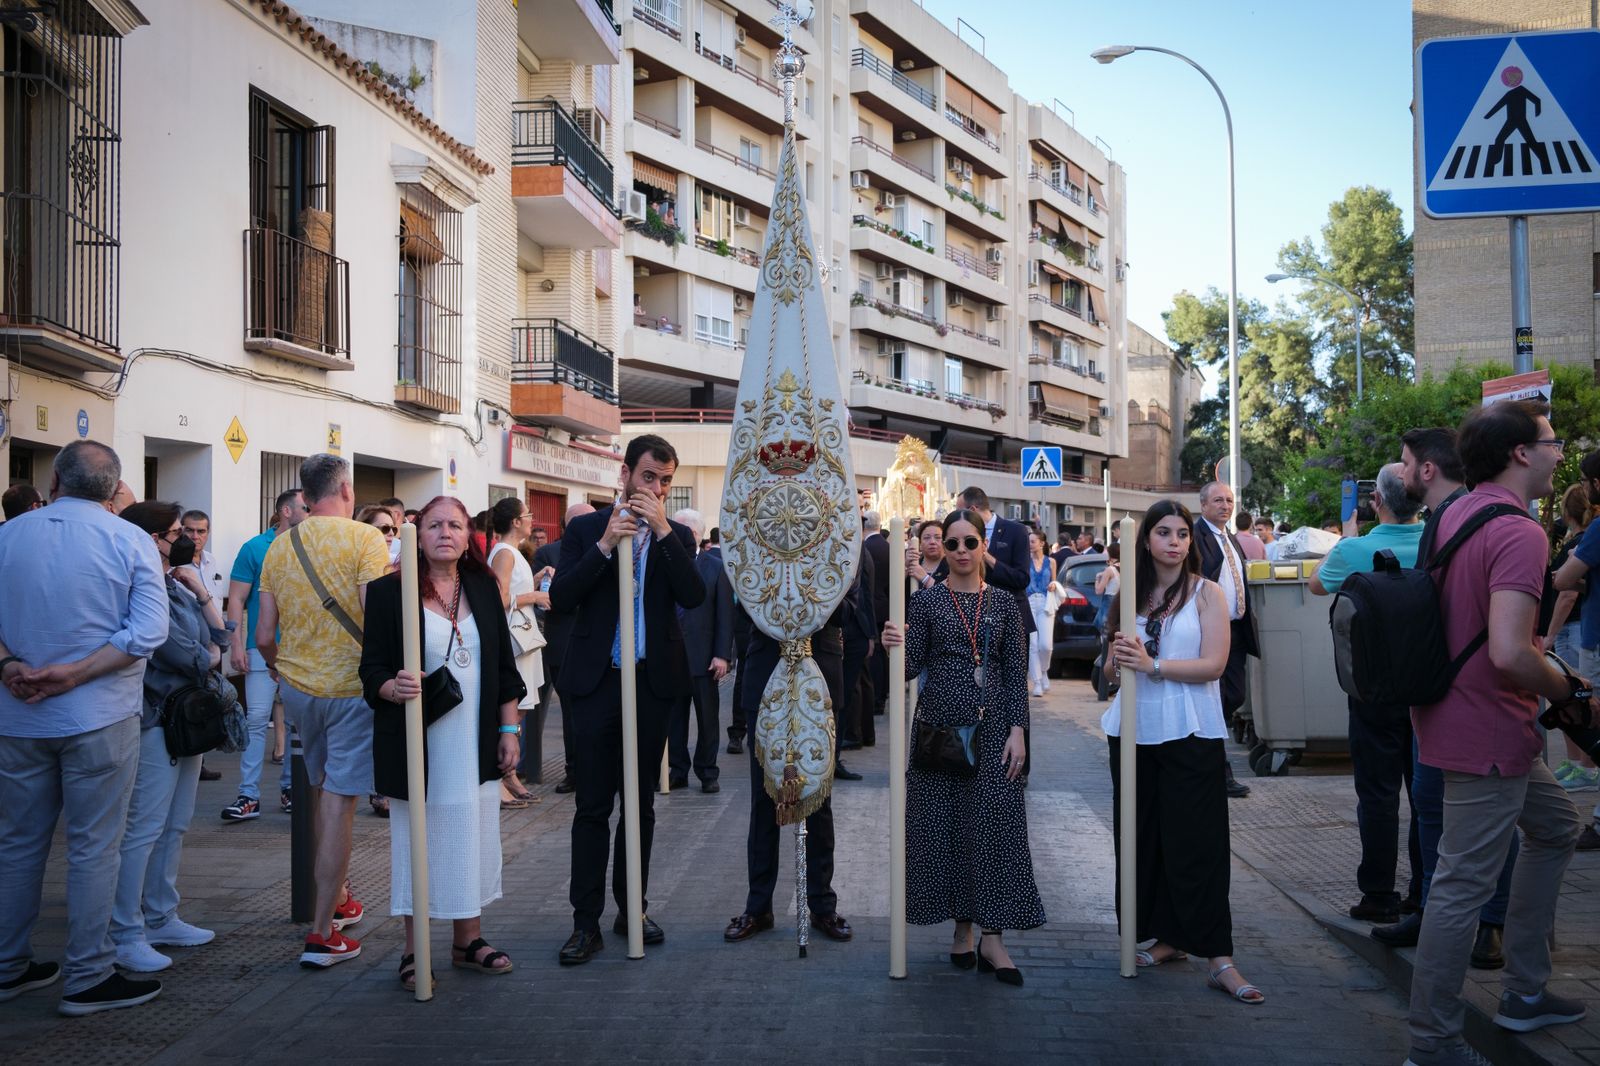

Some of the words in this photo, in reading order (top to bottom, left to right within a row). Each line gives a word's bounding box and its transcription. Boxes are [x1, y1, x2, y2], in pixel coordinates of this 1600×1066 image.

[479, 358, 489, 372] SAN
[179, 415, 188, 427] 23
[533, 458, 551, 473] VENTA
[554, 463, 575, 478] DIRECTA
[577, 467, 601, 481] MATADERO
